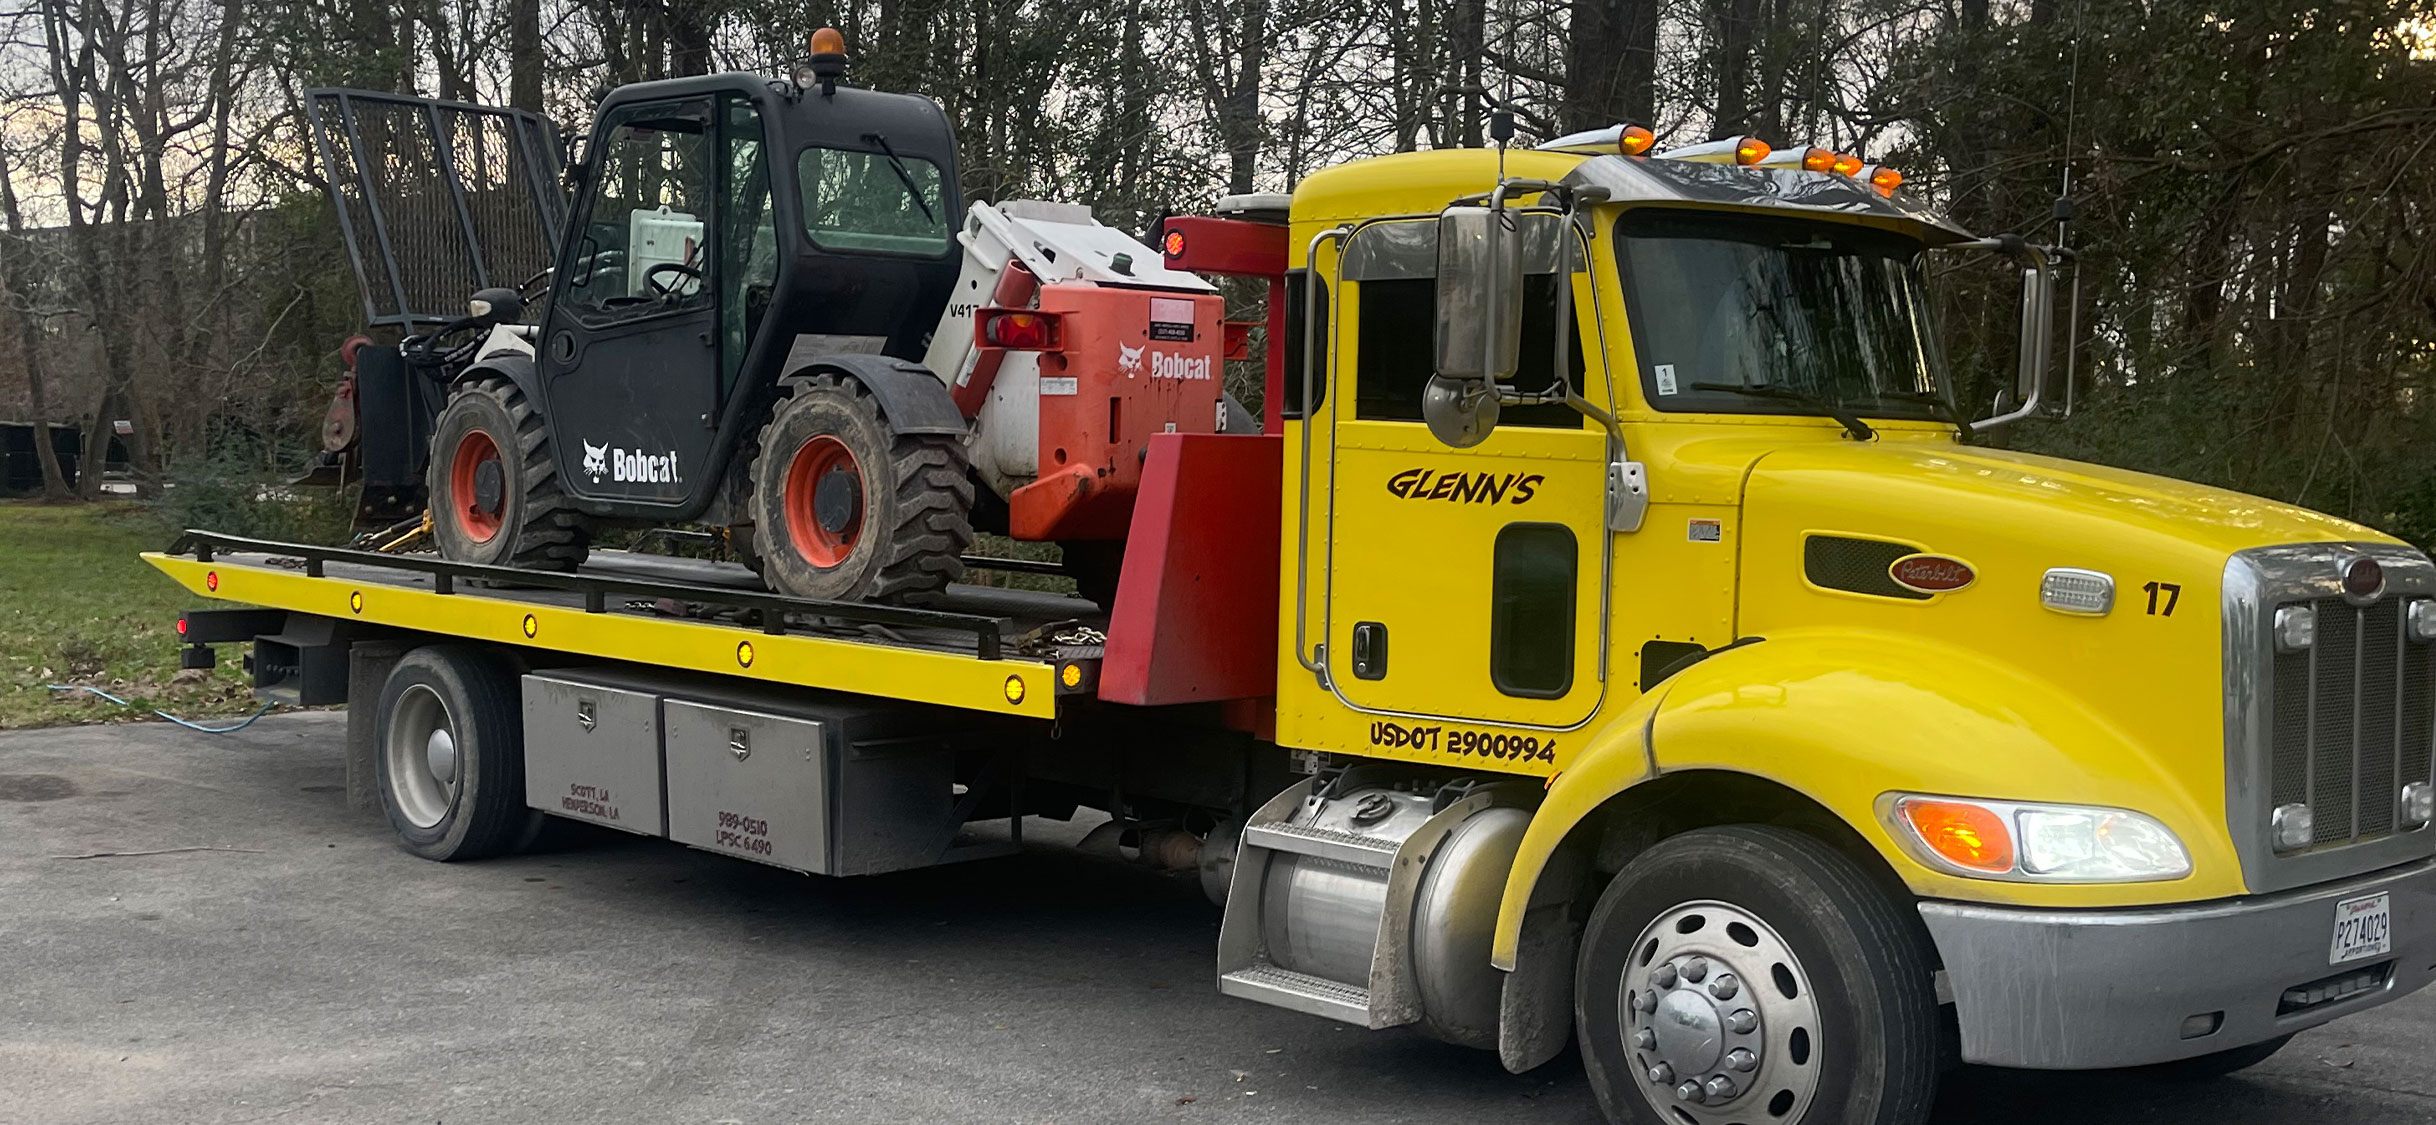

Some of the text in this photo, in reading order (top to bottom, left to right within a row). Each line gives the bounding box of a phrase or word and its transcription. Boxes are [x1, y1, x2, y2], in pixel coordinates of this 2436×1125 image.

[1152, 350, 1211, 381] Bobcat
[613, 448, 678, 484] Bobcat
[1387, 468, 1545, 505] GLENN'S
[1901, 560, 1966, 582] Peterbilt
[2143, 581, 2181, 617] 17
[1371, 721, 1442, 751] USDOT
[1447, 731, 1556, 765] 2900994
[716, 829, 742, 848] LPSC
[718, 811, 768, 837] 989-0510
[2336, 911, 2387, 950] P274029
